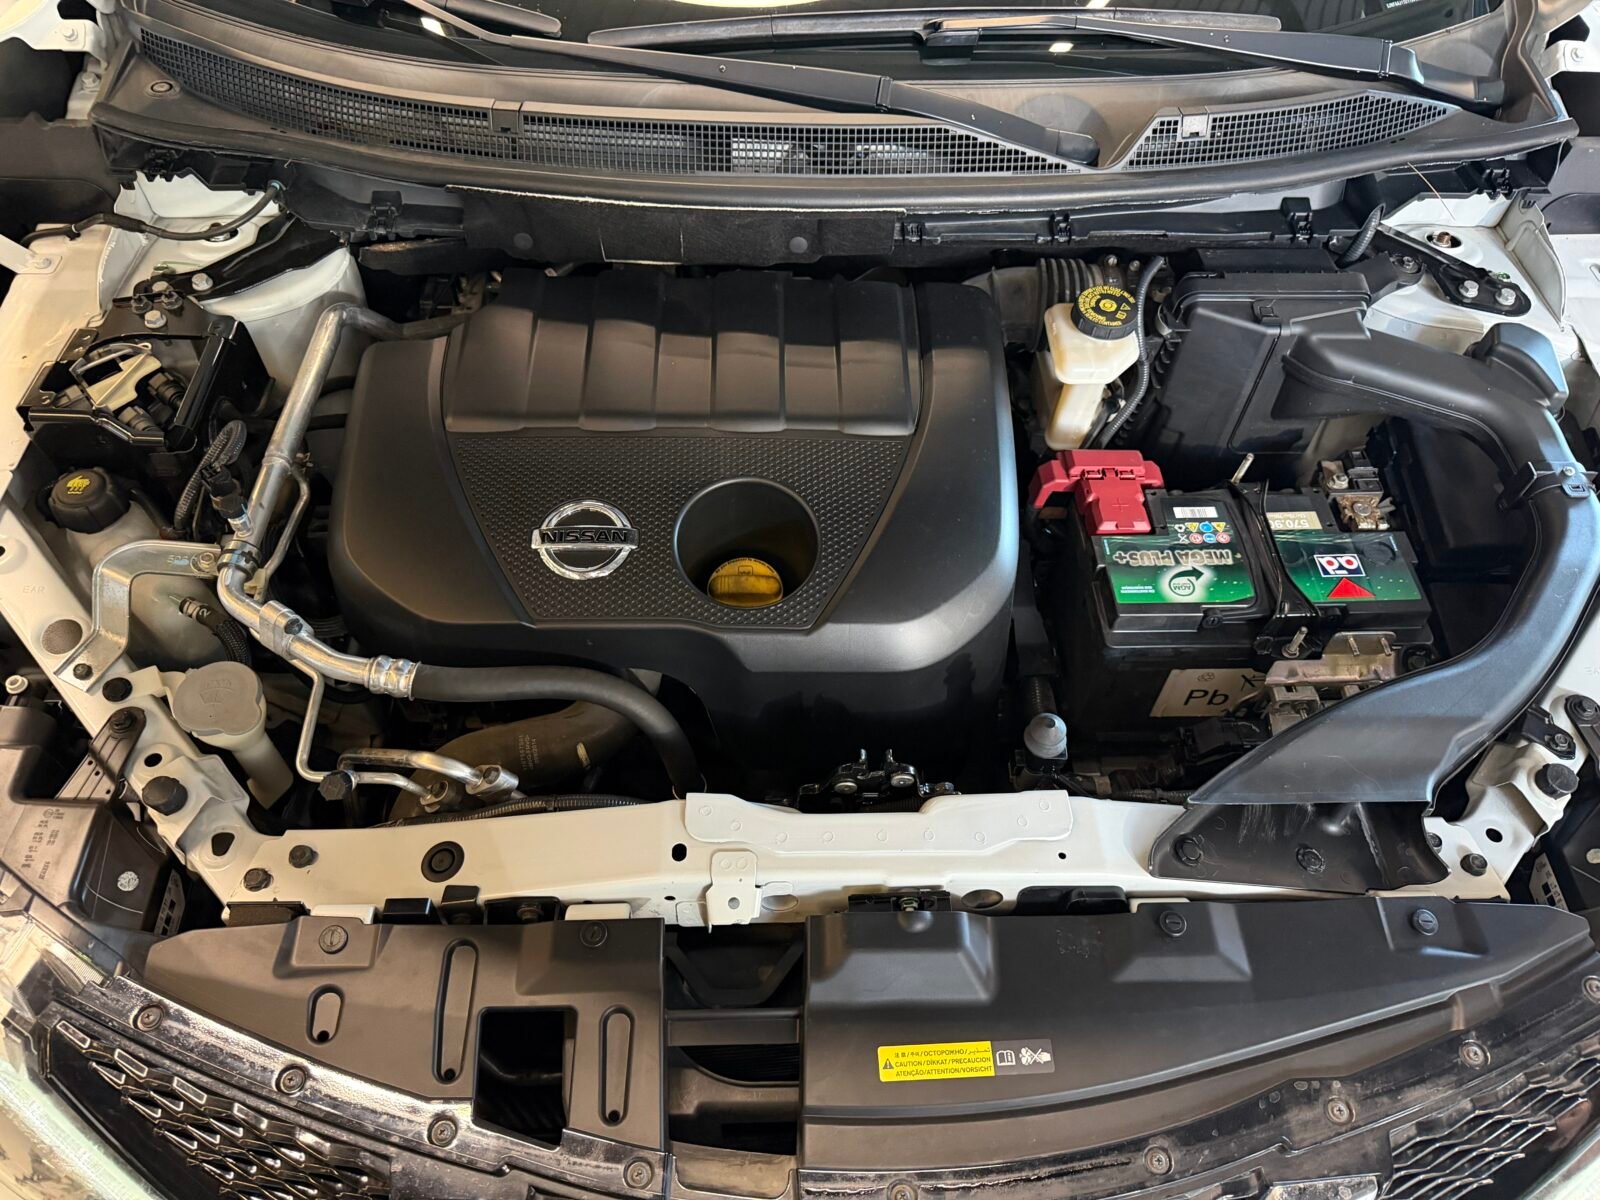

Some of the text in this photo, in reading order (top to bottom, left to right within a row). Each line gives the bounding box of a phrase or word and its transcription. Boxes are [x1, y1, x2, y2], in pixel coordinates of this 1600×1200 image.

[541, 530, 627, 543] NISSAN
[1112, 549, 1233, 567] MEGA PLUS+
[1183, 689, 1229, 706] Pb
